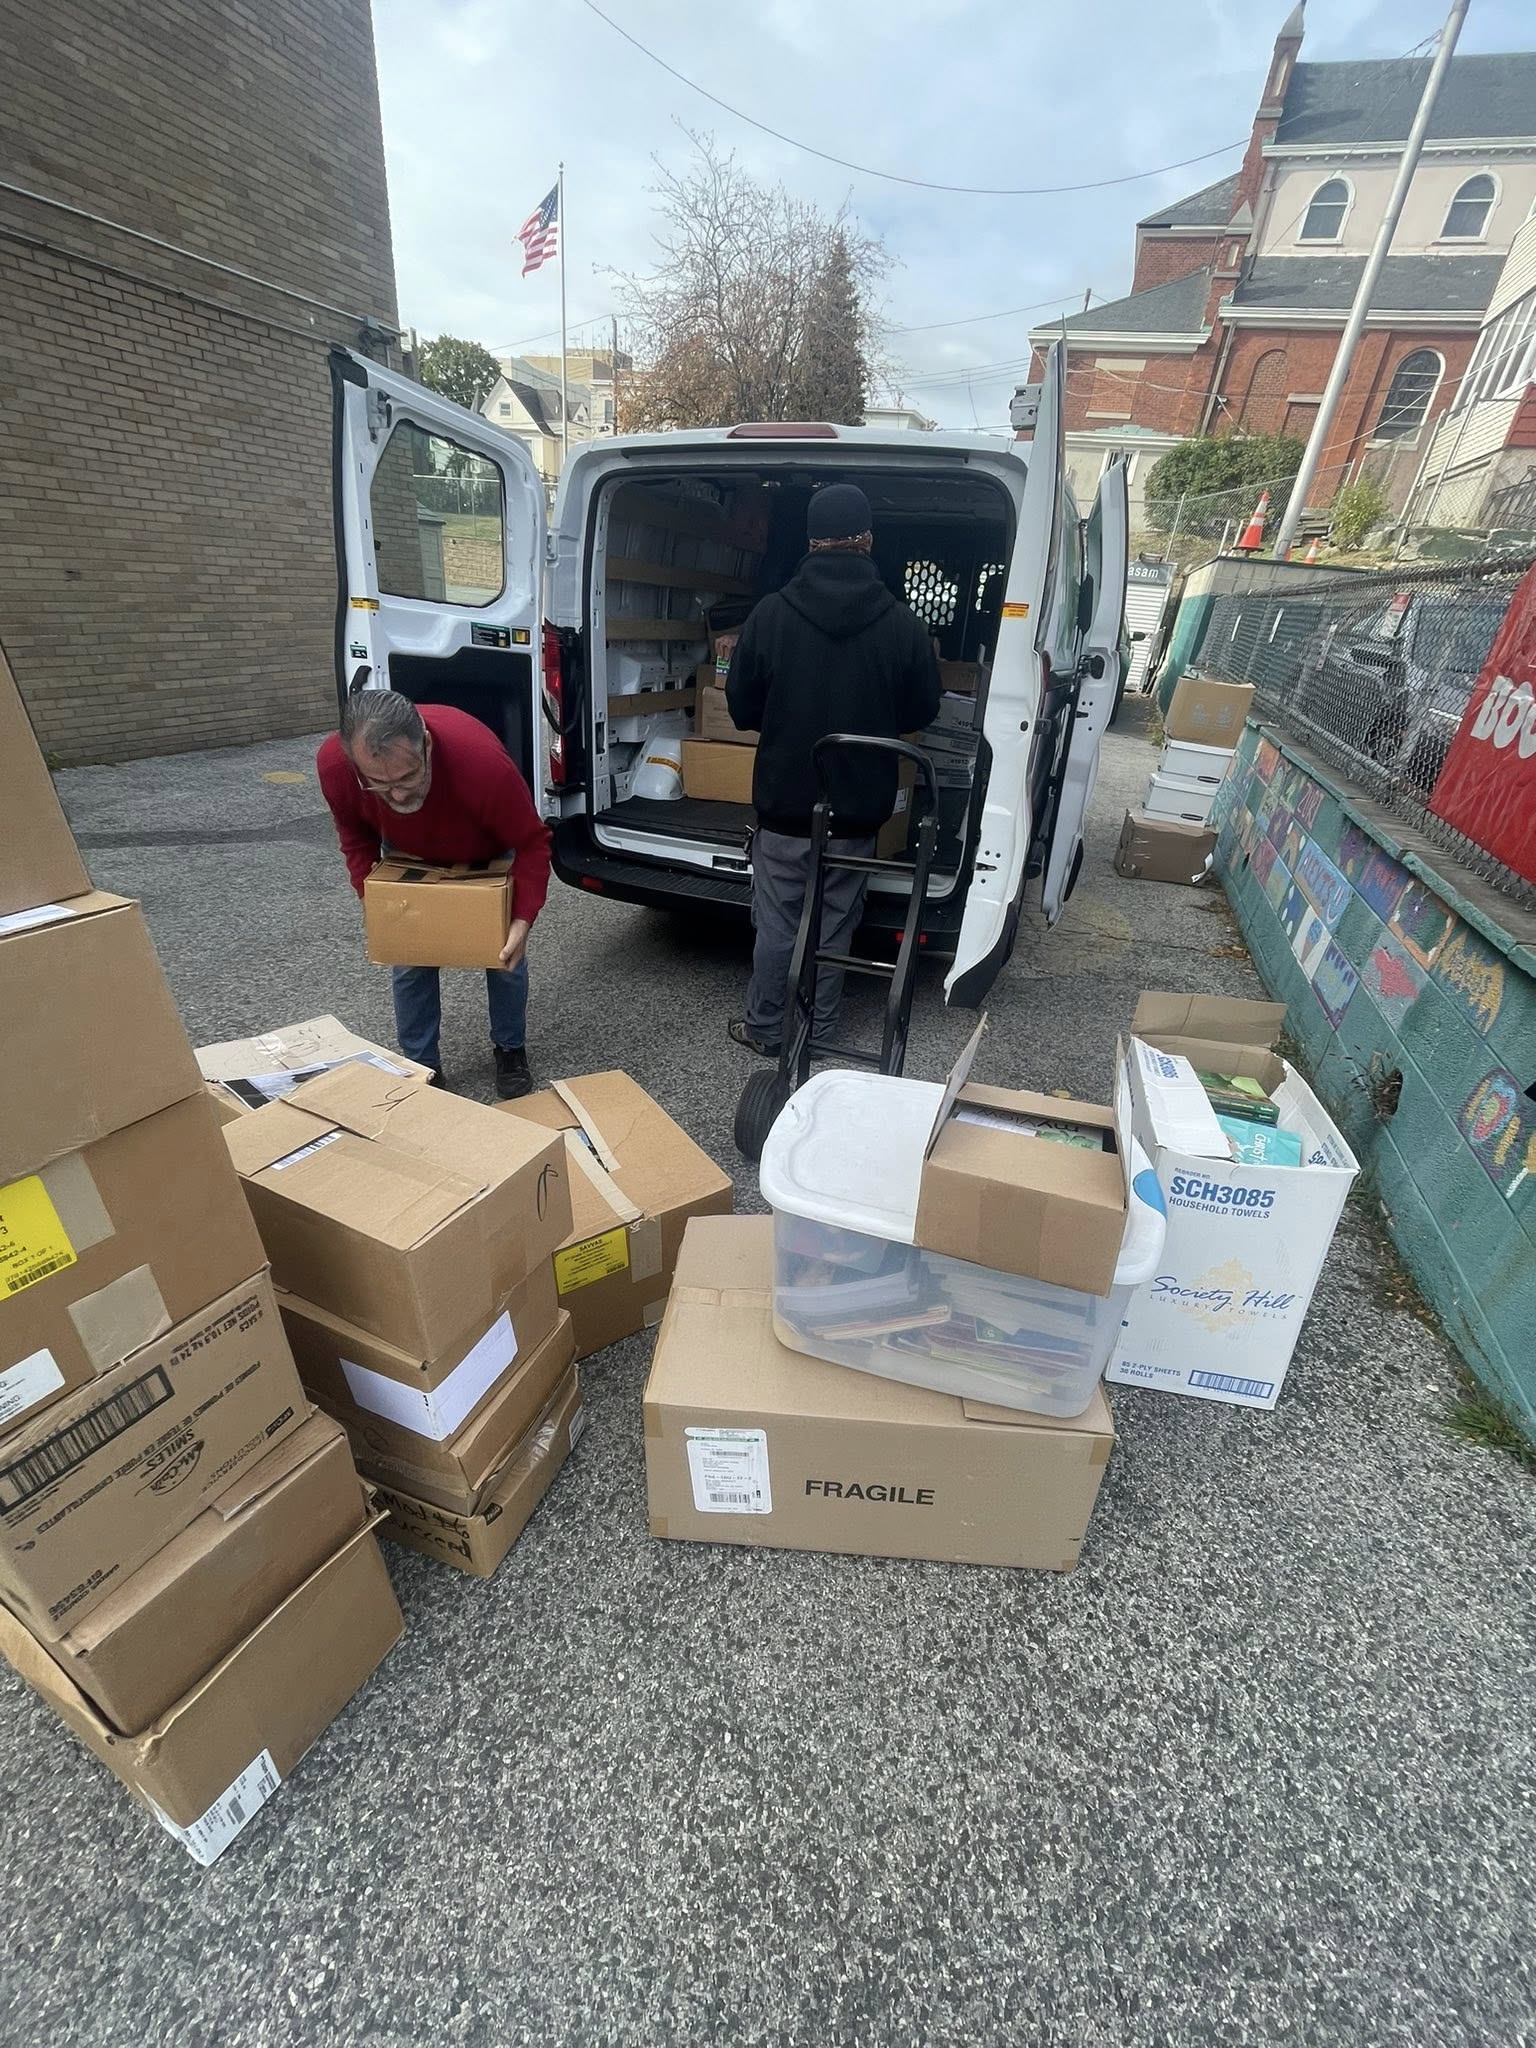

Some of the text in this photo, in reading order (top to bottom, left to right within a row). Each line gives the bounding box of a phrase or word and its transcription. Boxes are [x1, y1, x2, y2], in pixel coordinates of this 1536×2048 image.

[1128, 566, 1159, 578] asam
[1170, 1176, 1276, 1208] SCH3085
[1169, 1197, 1270, 1219] HOUSEHOLD TOWELS
[1149, 1294, 1288, 1320] LUXURY TOWELS
[1151, 1276, 1297, 1312] Society Hill
[1153, 1366, 1181, 1376] SHEETS
[146, 1428, 194, 1470] SMILES
[804, 1477, 936, 1506] FRAGILE
